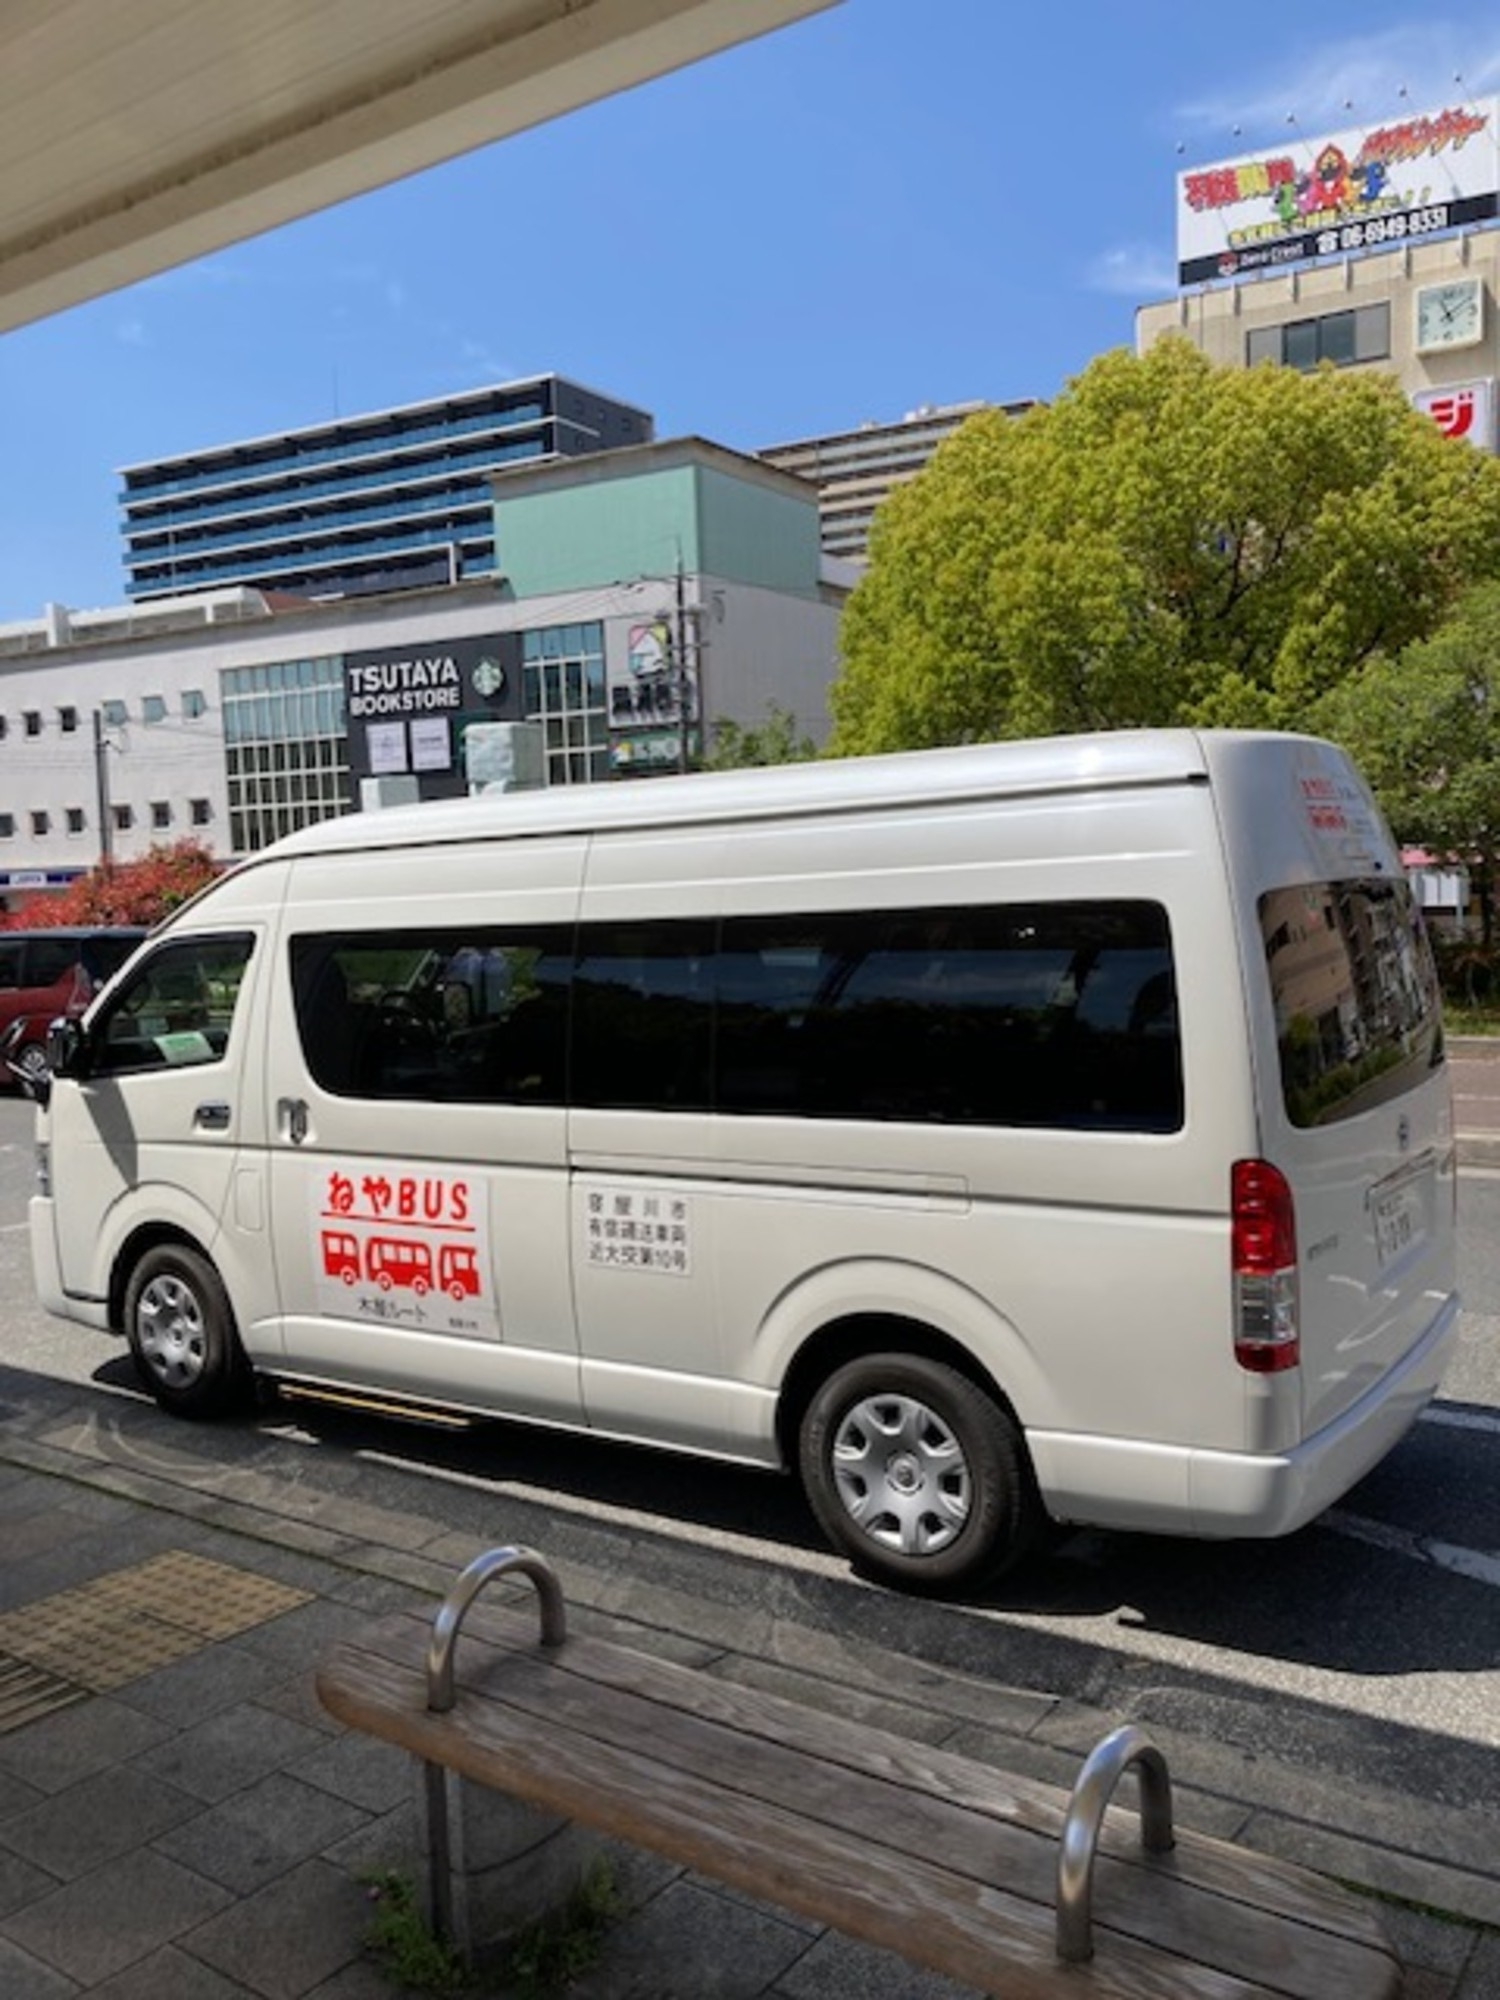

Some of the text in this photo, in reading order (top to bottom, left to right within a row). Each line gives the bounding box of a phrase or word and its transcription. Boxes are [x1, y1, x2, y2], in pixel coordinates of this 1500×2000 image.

[349, 657, 459, 694] TSUTAYA
[350, 687, 460, 717] BOOKSTORE
[328, 1171, 467, 1220] ねやBUS
